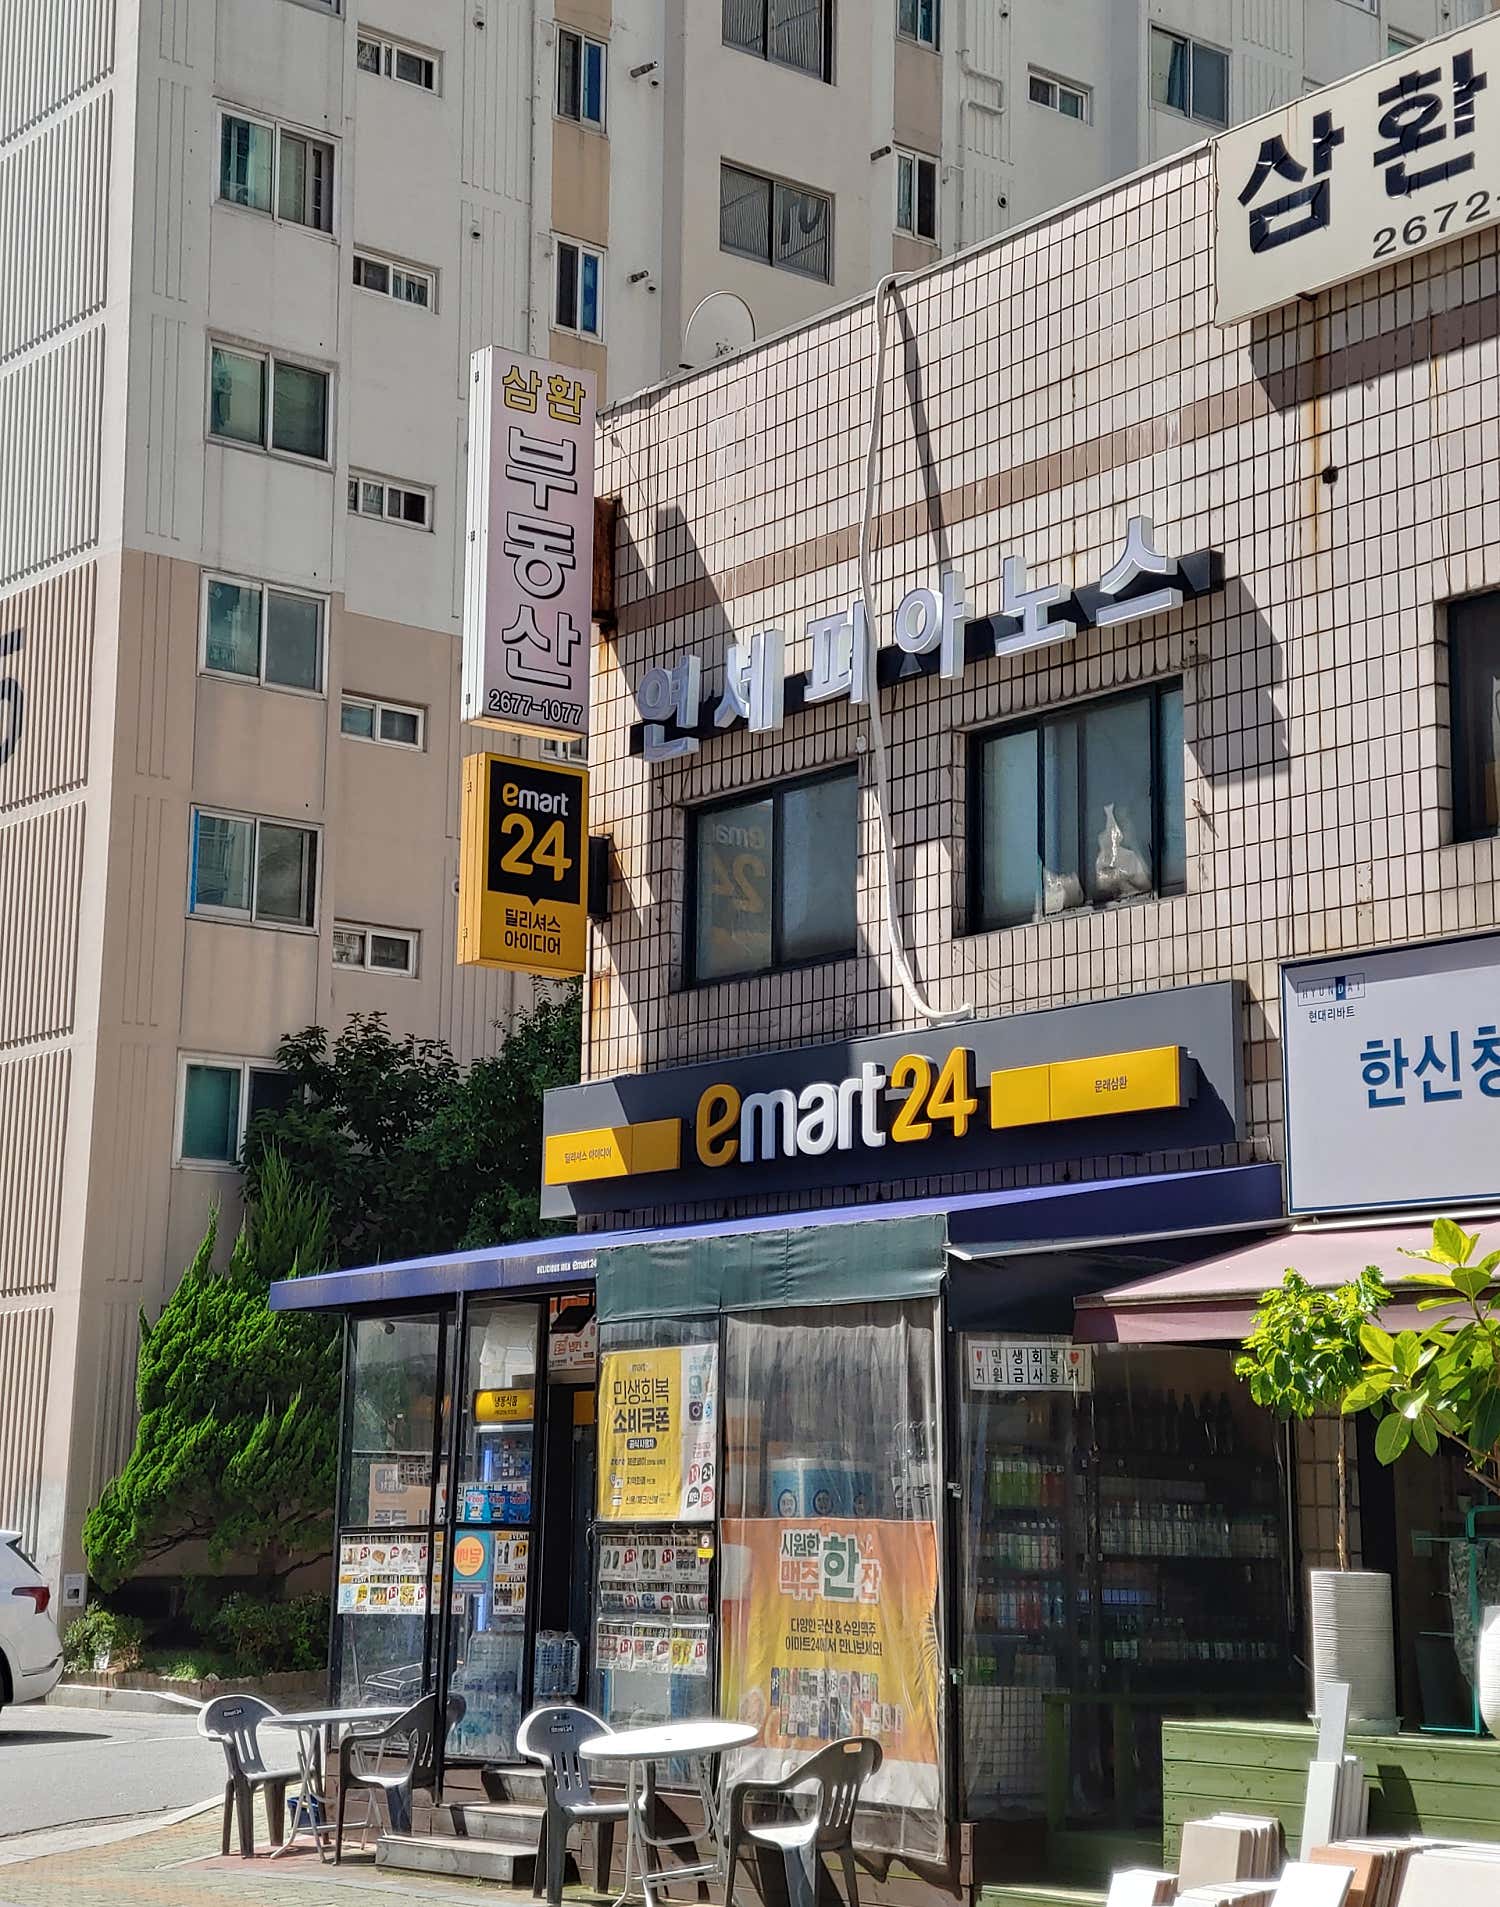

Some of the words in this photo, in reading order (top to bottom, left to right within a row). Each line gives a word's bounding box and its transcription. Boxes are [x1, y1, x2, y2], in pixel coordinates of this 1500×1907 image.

[1238, 48, 1487, 254] 삼환
[1373, 190, 1500, 259] 2672
[502, 364, 586, 424] 삼환
[502, 426, 581, 690] 부동산
[489, 689, 583, 725] 2677-1077
[502, 782, 569, 816] emart
[501, 813, 572, 882] 24
[505, 908, 561, 933] 딜리셔스
[504, 930, 561, 955] 아이디어
[1302, 981, 1360, 999] HYUNDAI
[1308, 1005, 1355, 1023] 현대리바트
[696, 1047, 978, 1168] emart24
[613, 1376, 669, 1406] 민생회복
[613, 1406, 670, 1434] 소비쿠폰
[781, 1532, 820, 1557] 시원한
[781, 1560, 820, 1598] 맥주
